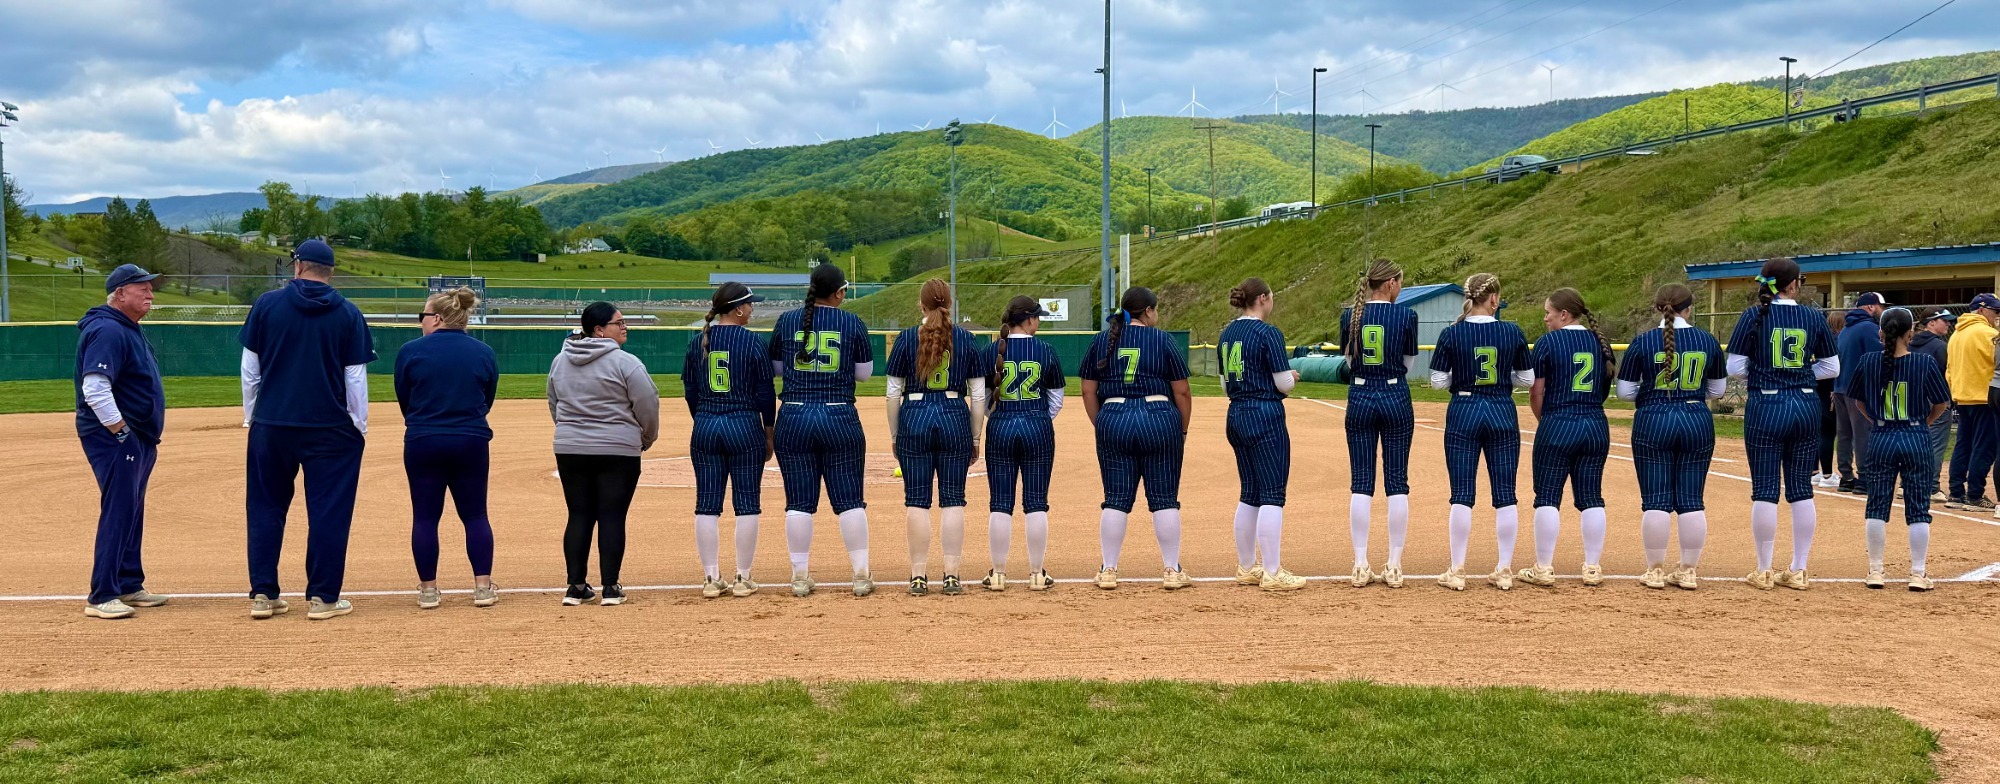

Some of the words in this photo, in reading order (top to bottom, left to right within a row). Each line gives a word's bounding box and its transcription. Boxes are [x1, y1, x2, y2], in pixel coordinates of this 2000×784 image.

[793, 331, 841, 373] 25
[1117, 347, 1141, 385] 7
[1221, 340, 1245, 383] 14
[1362, 324, 1385, 366] 9
[1474, 346, 1498, 386] 3
[1770, 327, 1807, 368] 13
[708, 350, 731, 393] 6
[996, 360, 1042, 402] 22
[1571, 351, 1595, 393] 2
[1653, 351, 1707, 391] 20
[1880, 380, 1909, 421] 11
